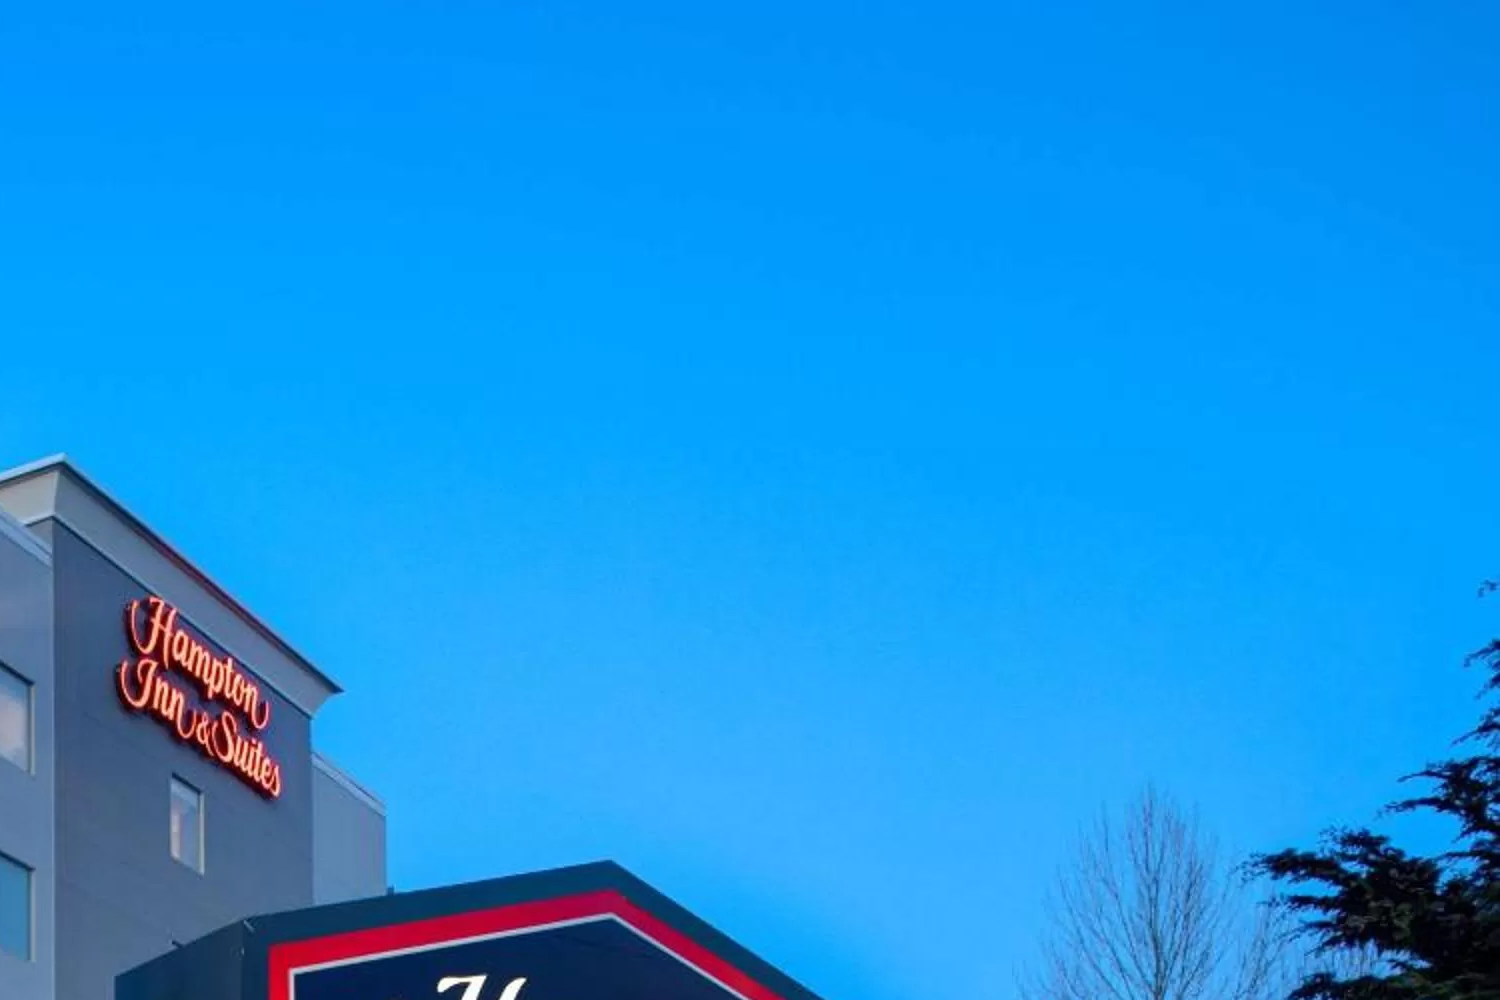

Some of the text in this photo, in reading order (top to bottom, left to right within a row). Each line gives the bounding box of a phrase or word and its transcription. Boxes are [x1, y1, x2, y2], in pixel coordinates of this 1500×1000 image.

[119, 658, 282, 798] Inn & Suites
[130, 596, 270, 730] Hampton
